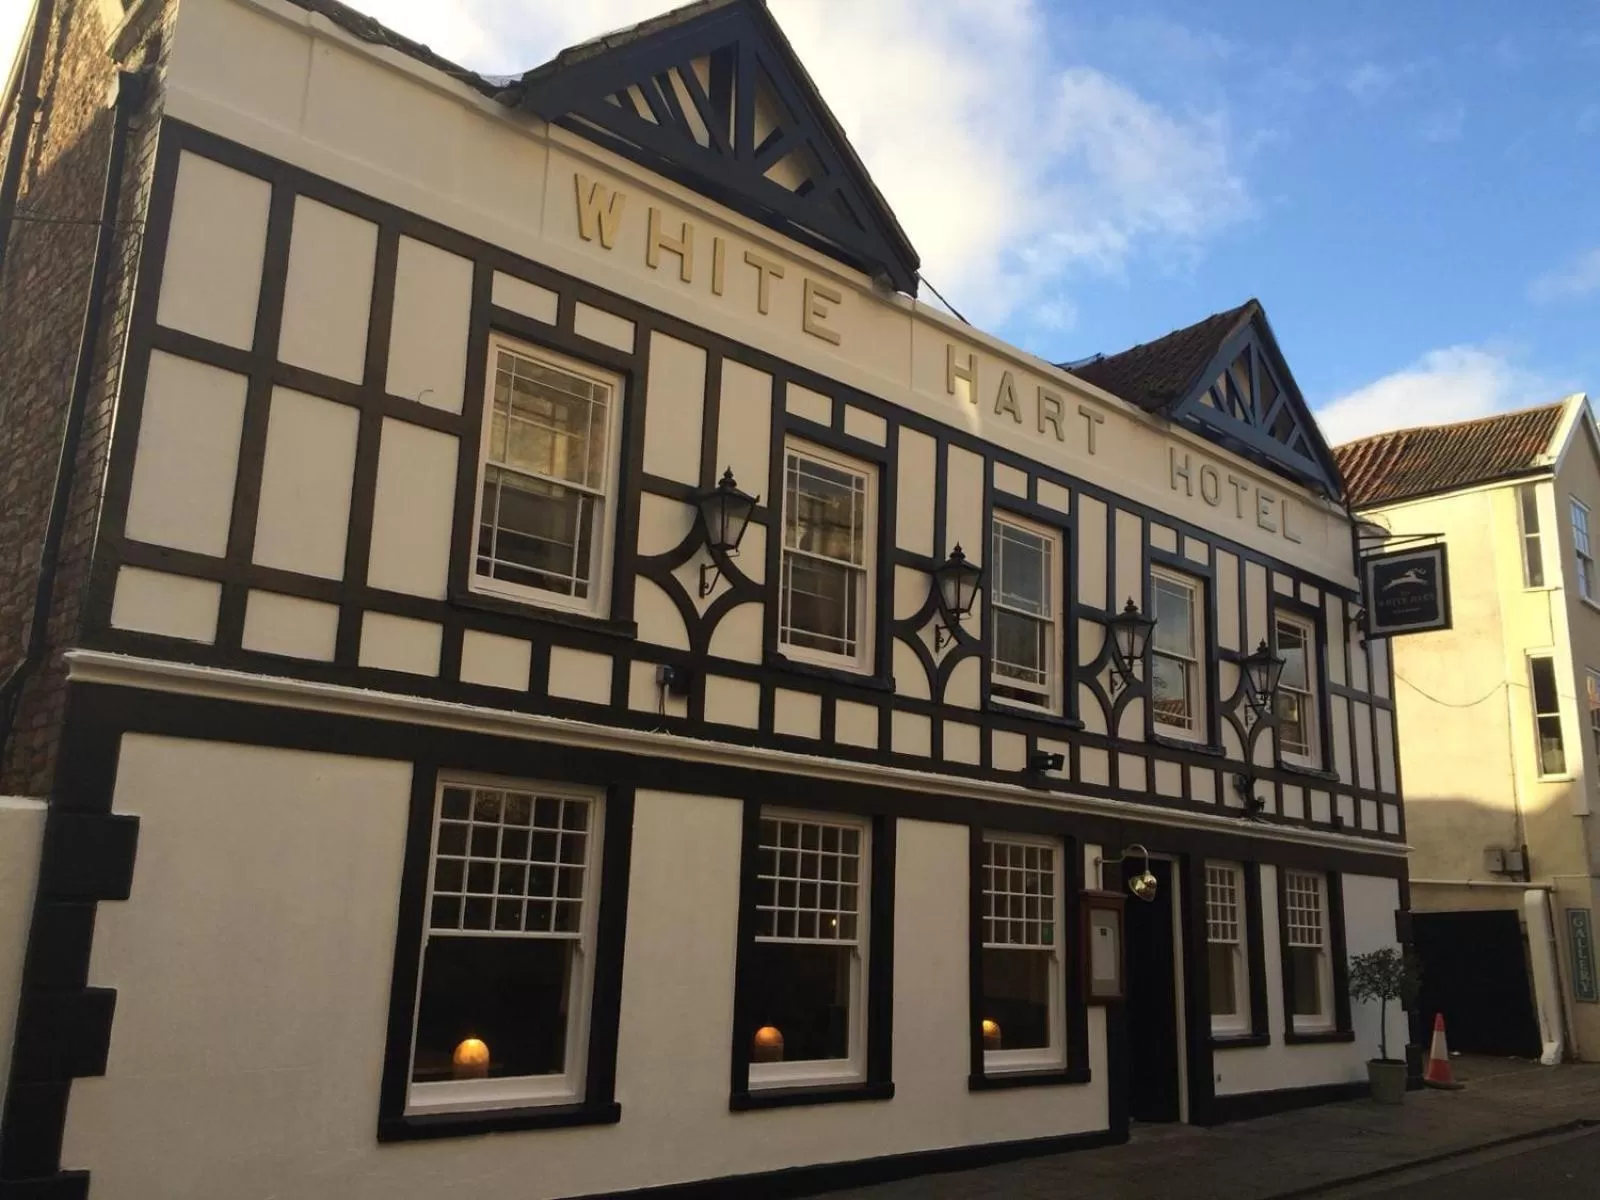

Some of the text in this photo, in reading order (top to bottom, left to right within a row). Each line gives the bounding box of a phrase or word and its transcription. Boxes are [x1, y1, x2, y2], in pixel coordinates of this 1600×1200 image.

[574, 172, 1302, 544] WHITE HART HOTEL
[1573, 917, 1591, 993] GALLERY
